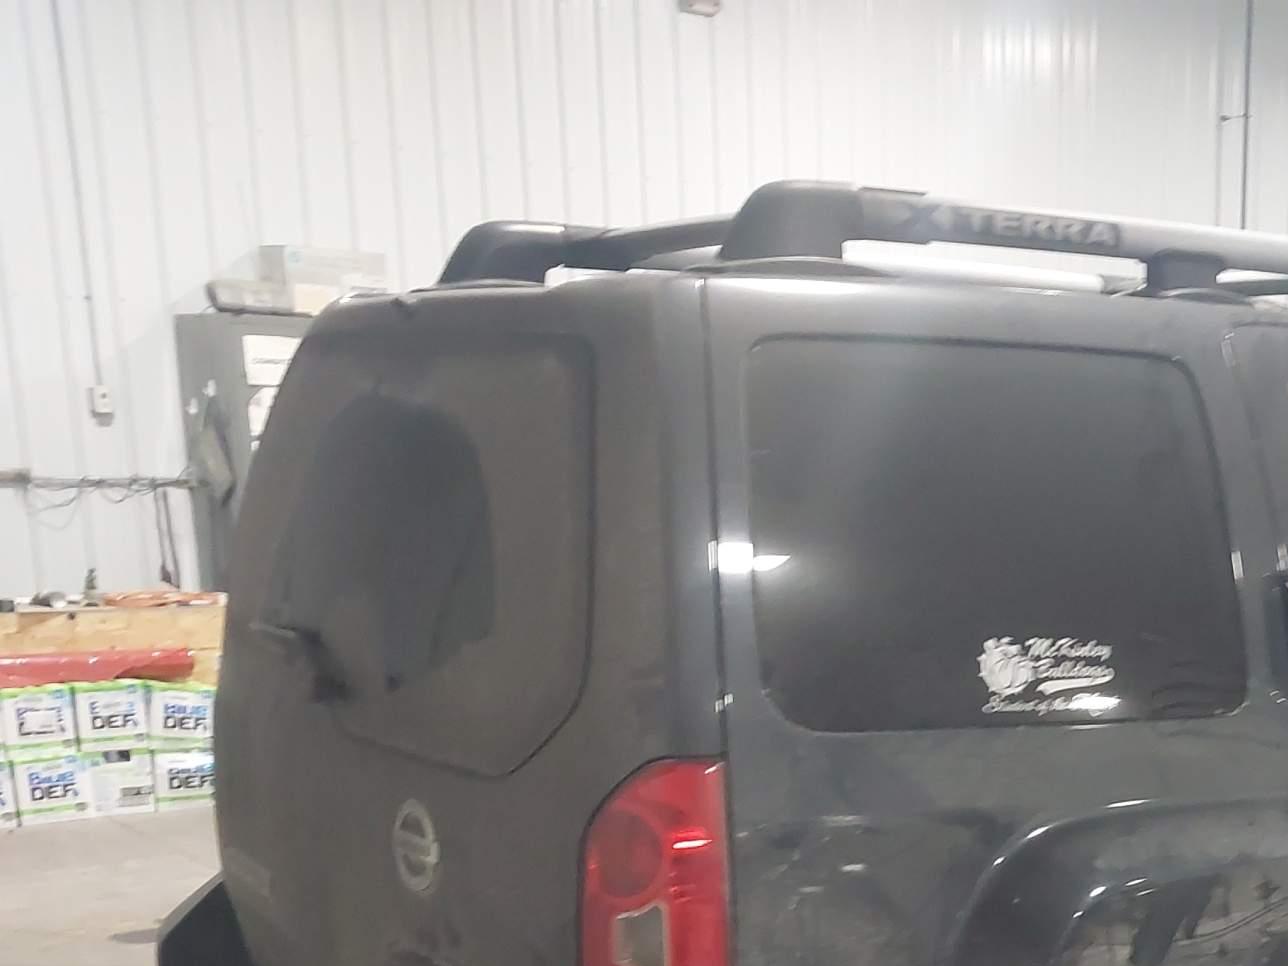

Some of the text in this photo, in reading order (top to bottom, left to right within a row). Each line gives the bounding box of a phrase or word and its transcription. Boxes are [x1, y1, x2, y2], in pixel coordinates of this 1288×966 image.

[91, 713, 138, 730] DEF
[163, 716, 207, 732] DEF
[31, 783, 79, 801] DEF
